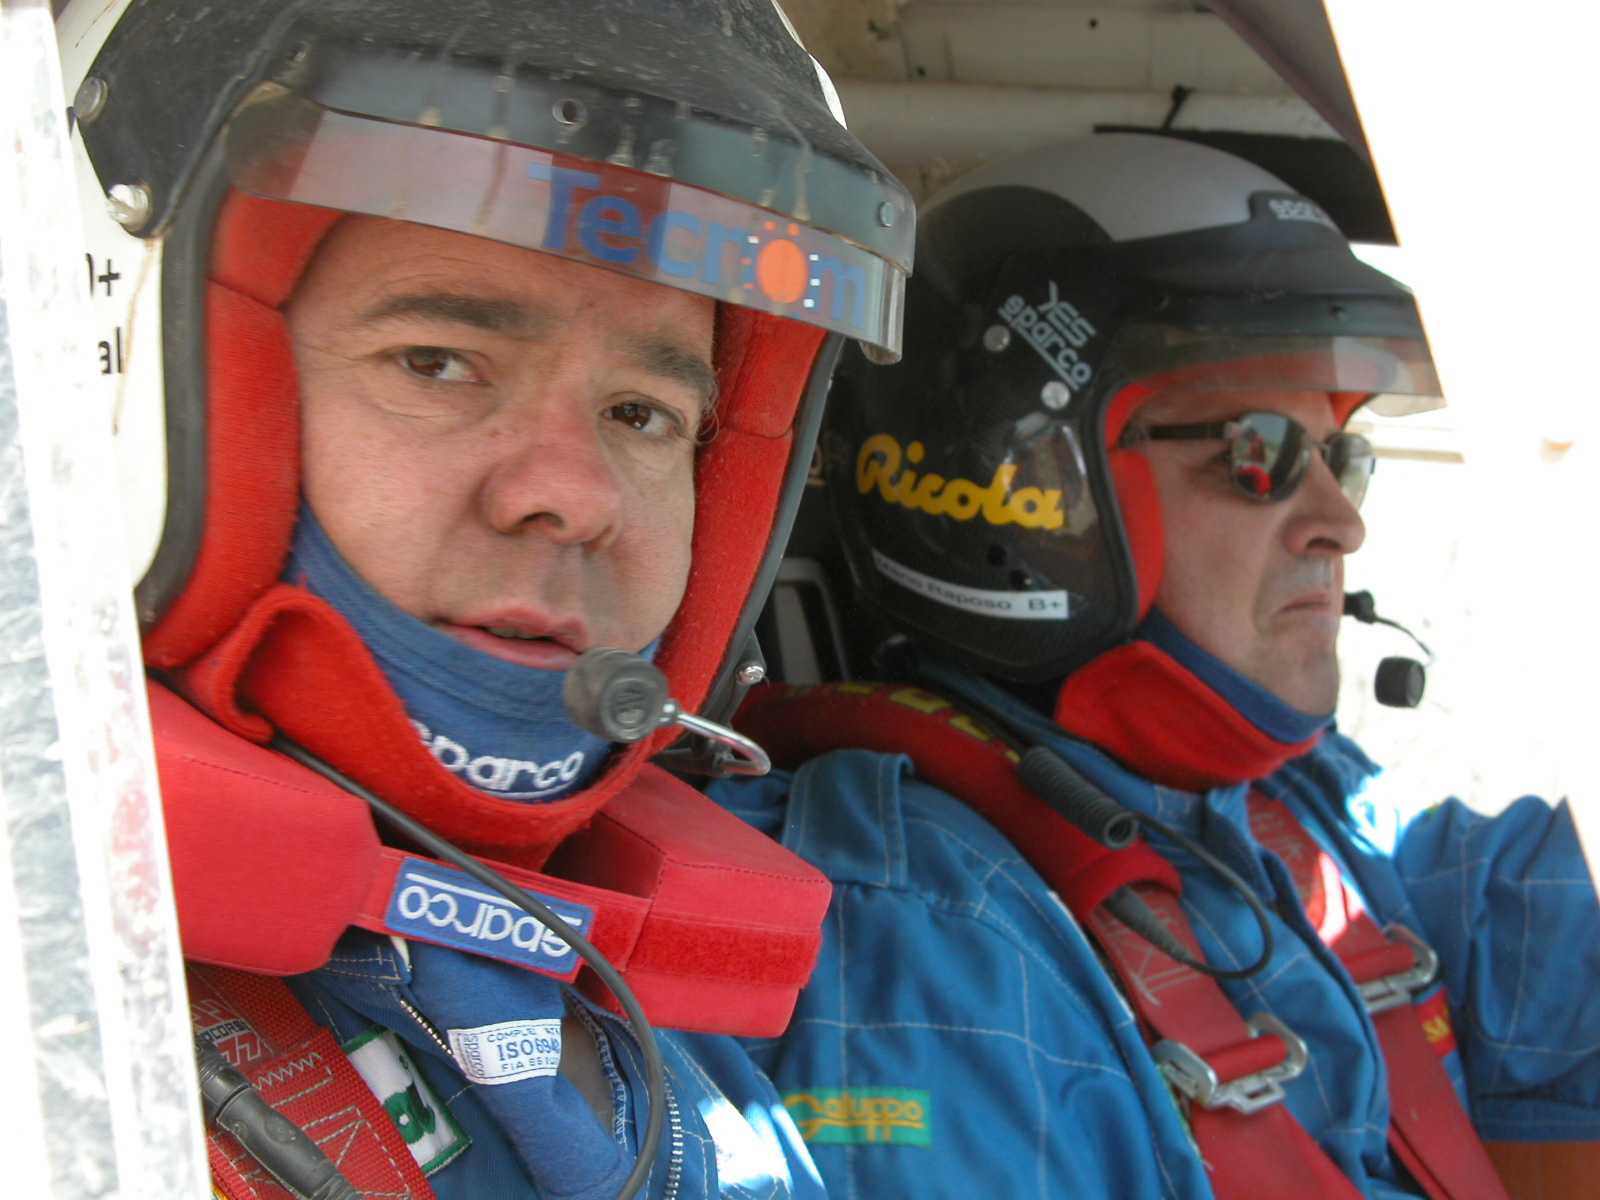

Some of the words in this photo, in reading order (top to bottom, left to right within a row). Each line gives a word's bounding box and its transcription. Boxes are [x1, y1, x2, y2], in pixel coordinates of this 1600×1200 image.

[999, 294, 1093, 388] sparco
[1037, 280, 1097, 348] YES
[856, 433, 1067, 531] Ricola
[1027, 597, 1063, 612] B+
[463, 1035, 486, 1077] sparco
